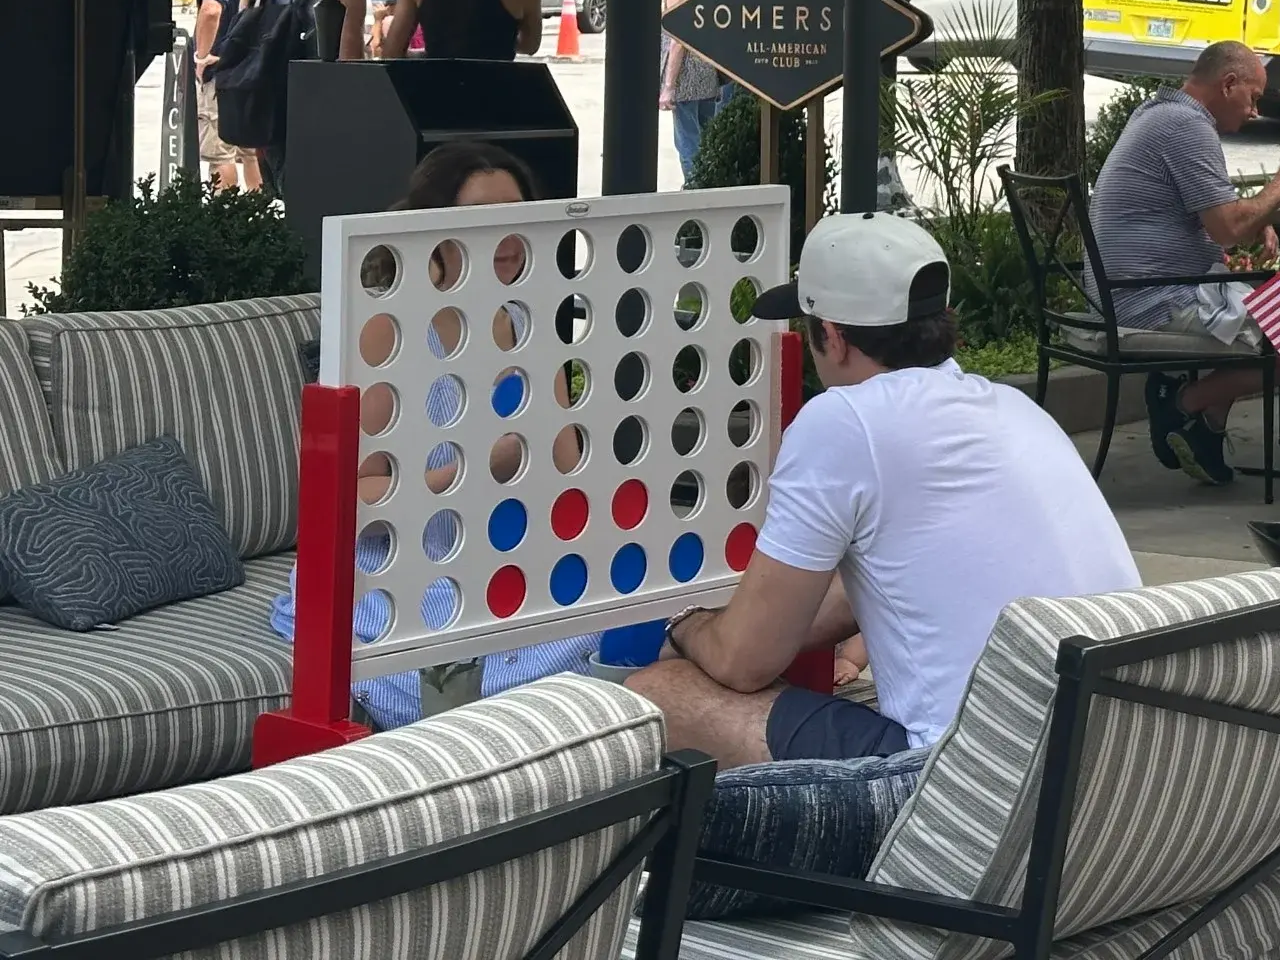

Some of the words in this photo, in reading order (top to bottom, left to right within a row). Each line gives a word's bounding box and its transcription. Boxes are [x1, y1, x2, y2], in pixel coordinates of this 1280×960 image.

[694, 4, 838, 31] SOMERS
[746, 42, 827, 55] ALL-AMERICAN
[772, 56, 800, 68] CLUB
